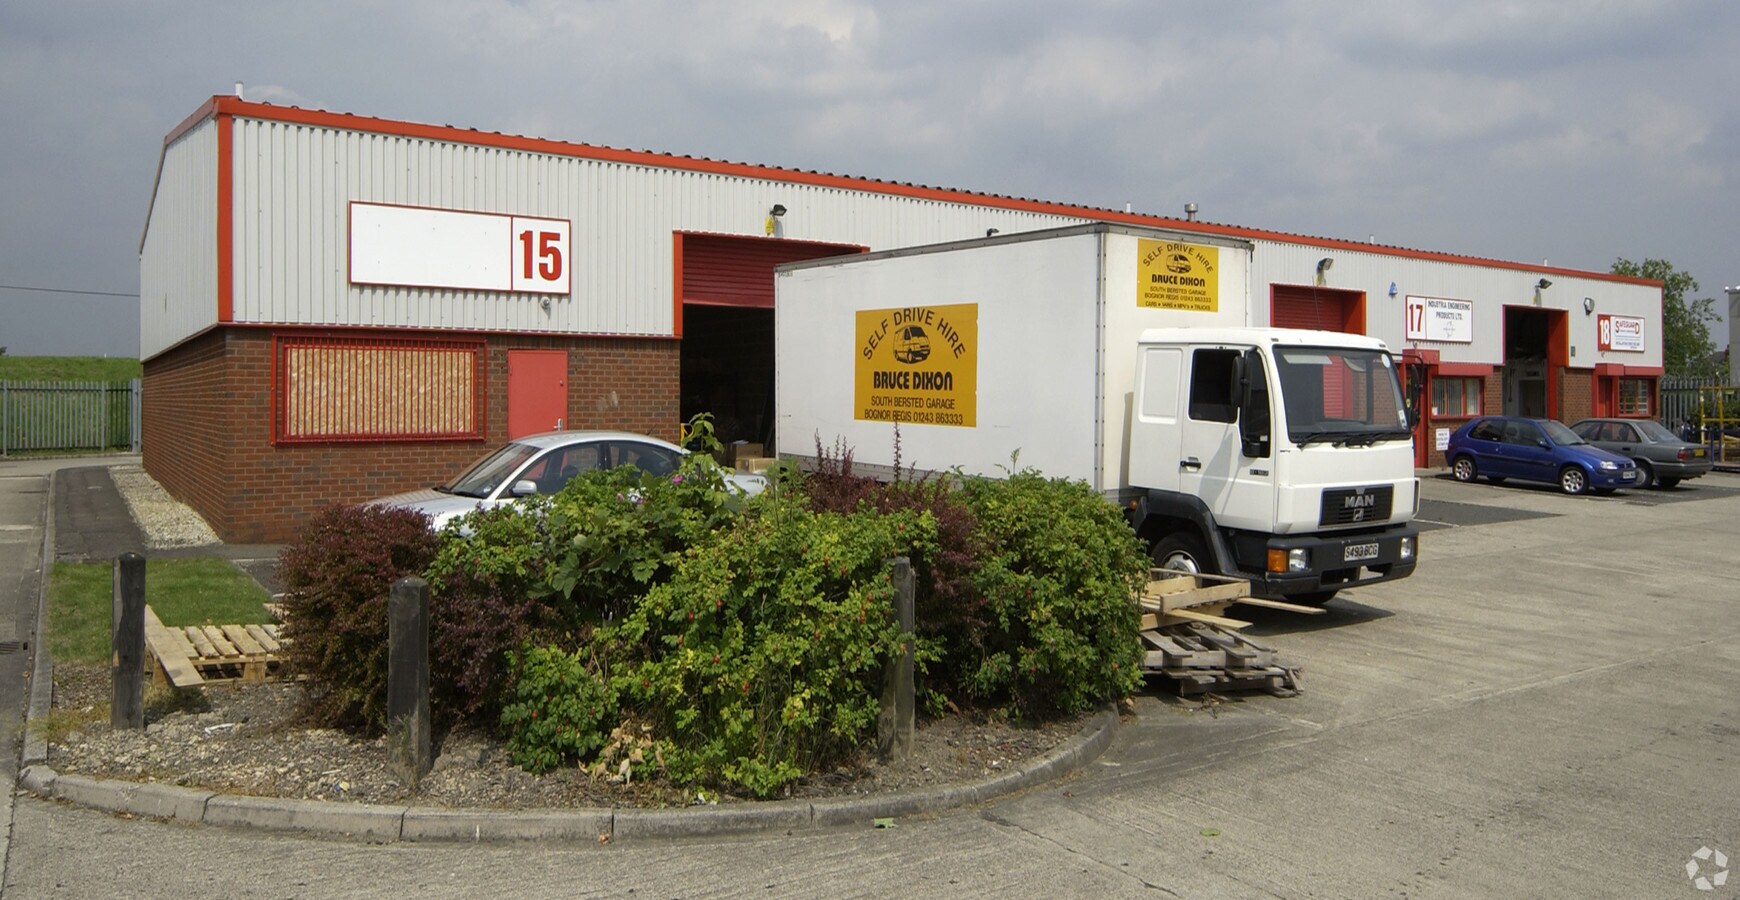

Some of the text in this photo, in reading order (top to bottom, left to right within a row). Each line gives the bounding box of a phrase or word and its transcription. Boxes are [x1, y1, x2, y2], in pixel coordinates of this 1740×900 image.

[520, 230, 562, 281] 15
[1143, 243, 1214, 273] SELF DRIVE HIRE
[1152, 274, 1205, 287] BRUCE DIXON
[1448, 302, 1470, 310] ENGINEERING
[1409, 304, 1423, 332] 17
[1436, 311, 1454, 320] PRODUCTS
[863, 307, 966, 360] SELF DRIVE HIRE
[1600, 320, 1610, 345] 18
[874, 371, 953, 391] BRUCE DIXON
[871, 396, 955, 410] SOUTH BERSTED GARAGE
[864, 408, 964, 425] BOGNOR REGIS 01243 863333
[1344, 494, 1374, 508] MAN
[1346, 545, 1364, 558] S493
